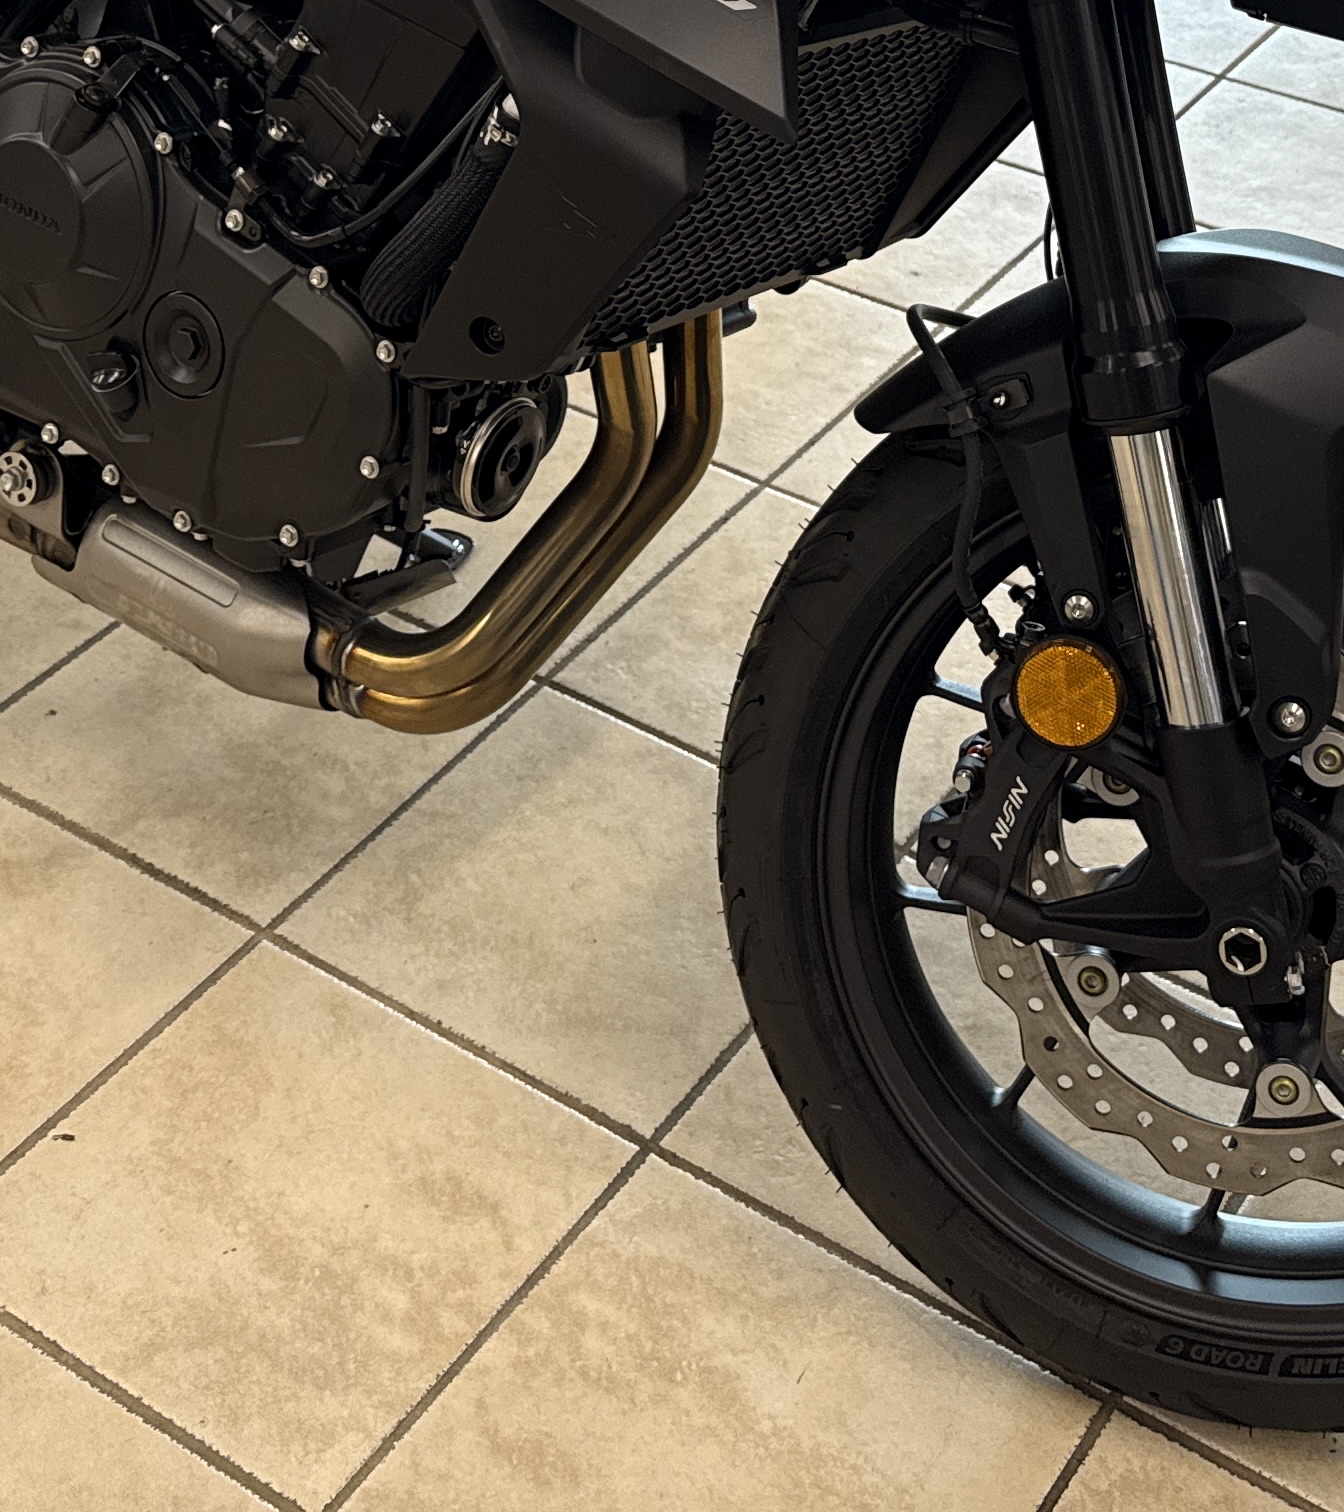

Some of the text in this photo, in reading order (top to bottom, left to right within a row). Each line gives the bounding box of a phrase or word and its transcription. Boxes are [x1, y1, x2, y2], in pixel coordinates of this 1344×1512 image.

[990, 775, 1029, 851] NISSIN
[1164, 1338, 1267, 1376] ROAD 6
